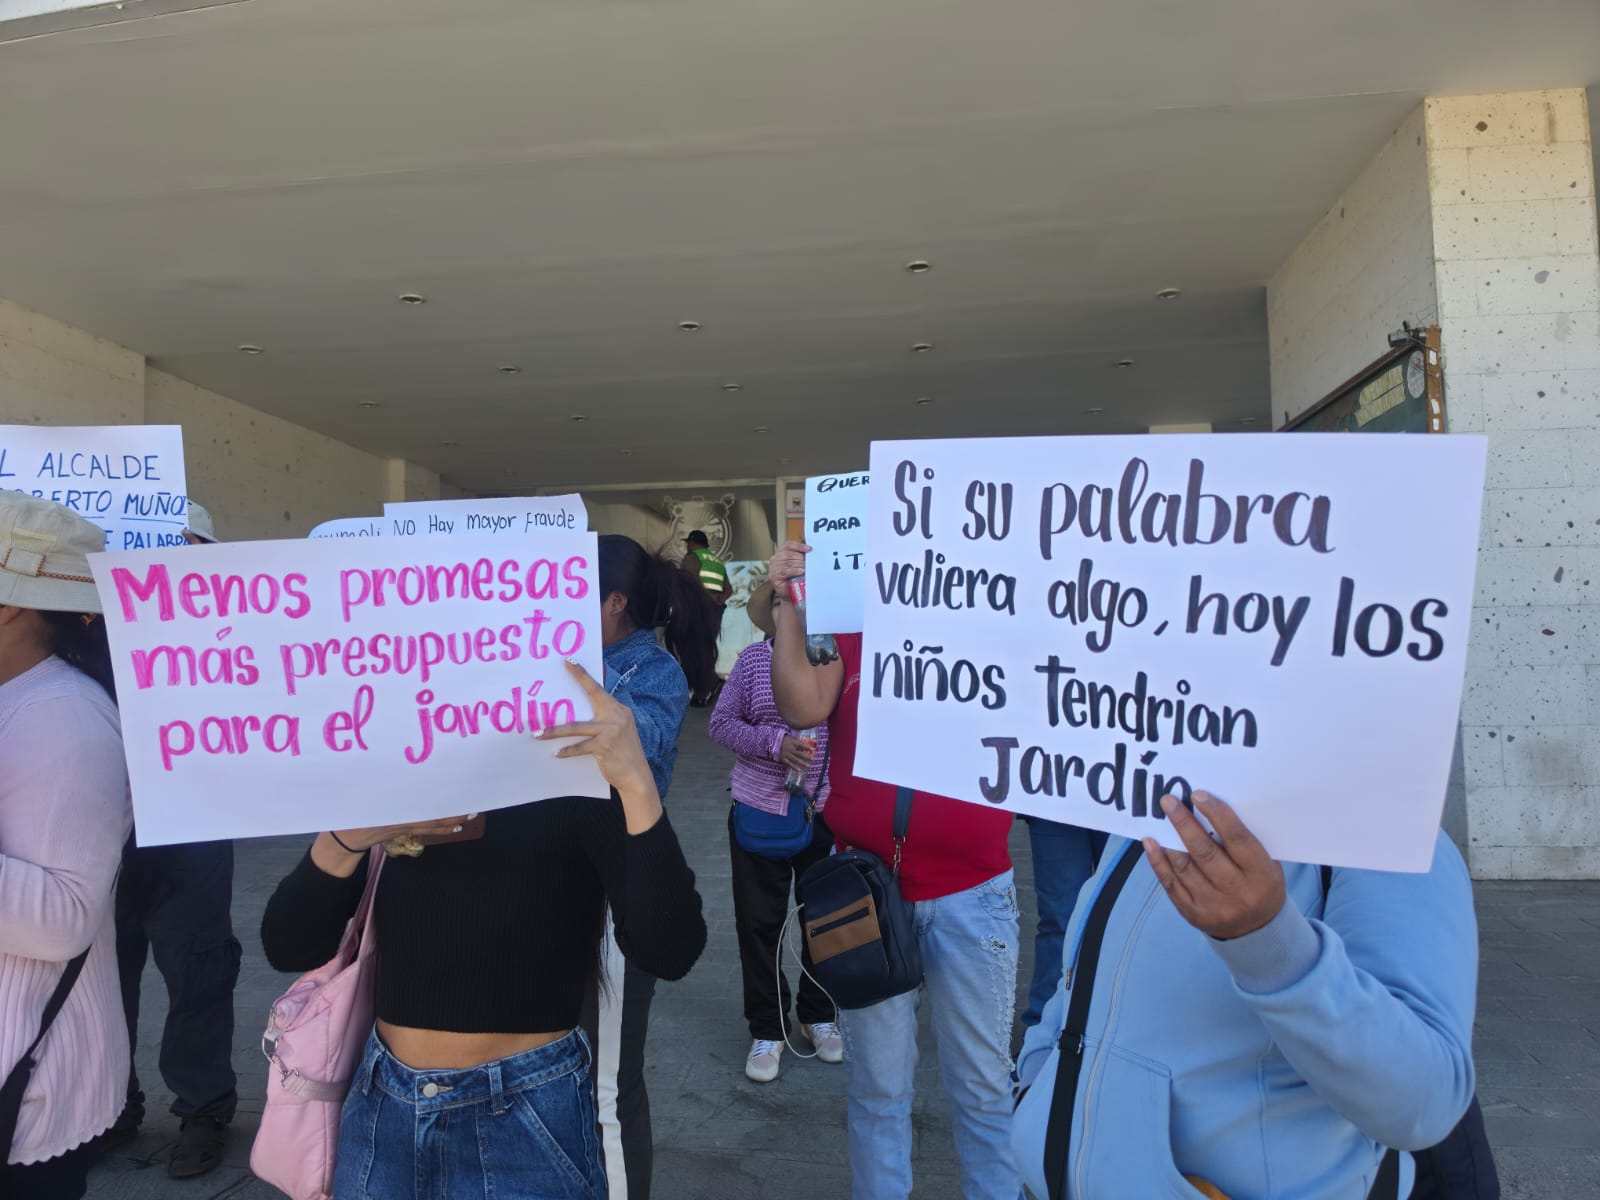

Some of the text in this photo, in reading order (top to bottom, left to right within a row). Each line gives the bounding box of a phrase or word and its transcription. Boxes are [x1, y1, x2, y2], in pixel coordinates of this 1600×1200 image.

[37, 452, 161, 480] ALCALDE
[893, 456, 1336, 561] Si su palabra
[394, 519, 416, 536] NO
[429, 514, 455, 533] Hay
[467, 511, 517, 534] mayor
[813, 516, 861, 533] PARA
[110, 555, 589, 623] Menos promesas
[875, 549, 1449, 666] valiera algo, hoy los
[130, 609, 585, 696] más presupuesto
[872, 639, 1258, 748] niños tendrian
[158, 679, 576, 772] para el jardín
[977, 736, 1195, 820] Jardín
